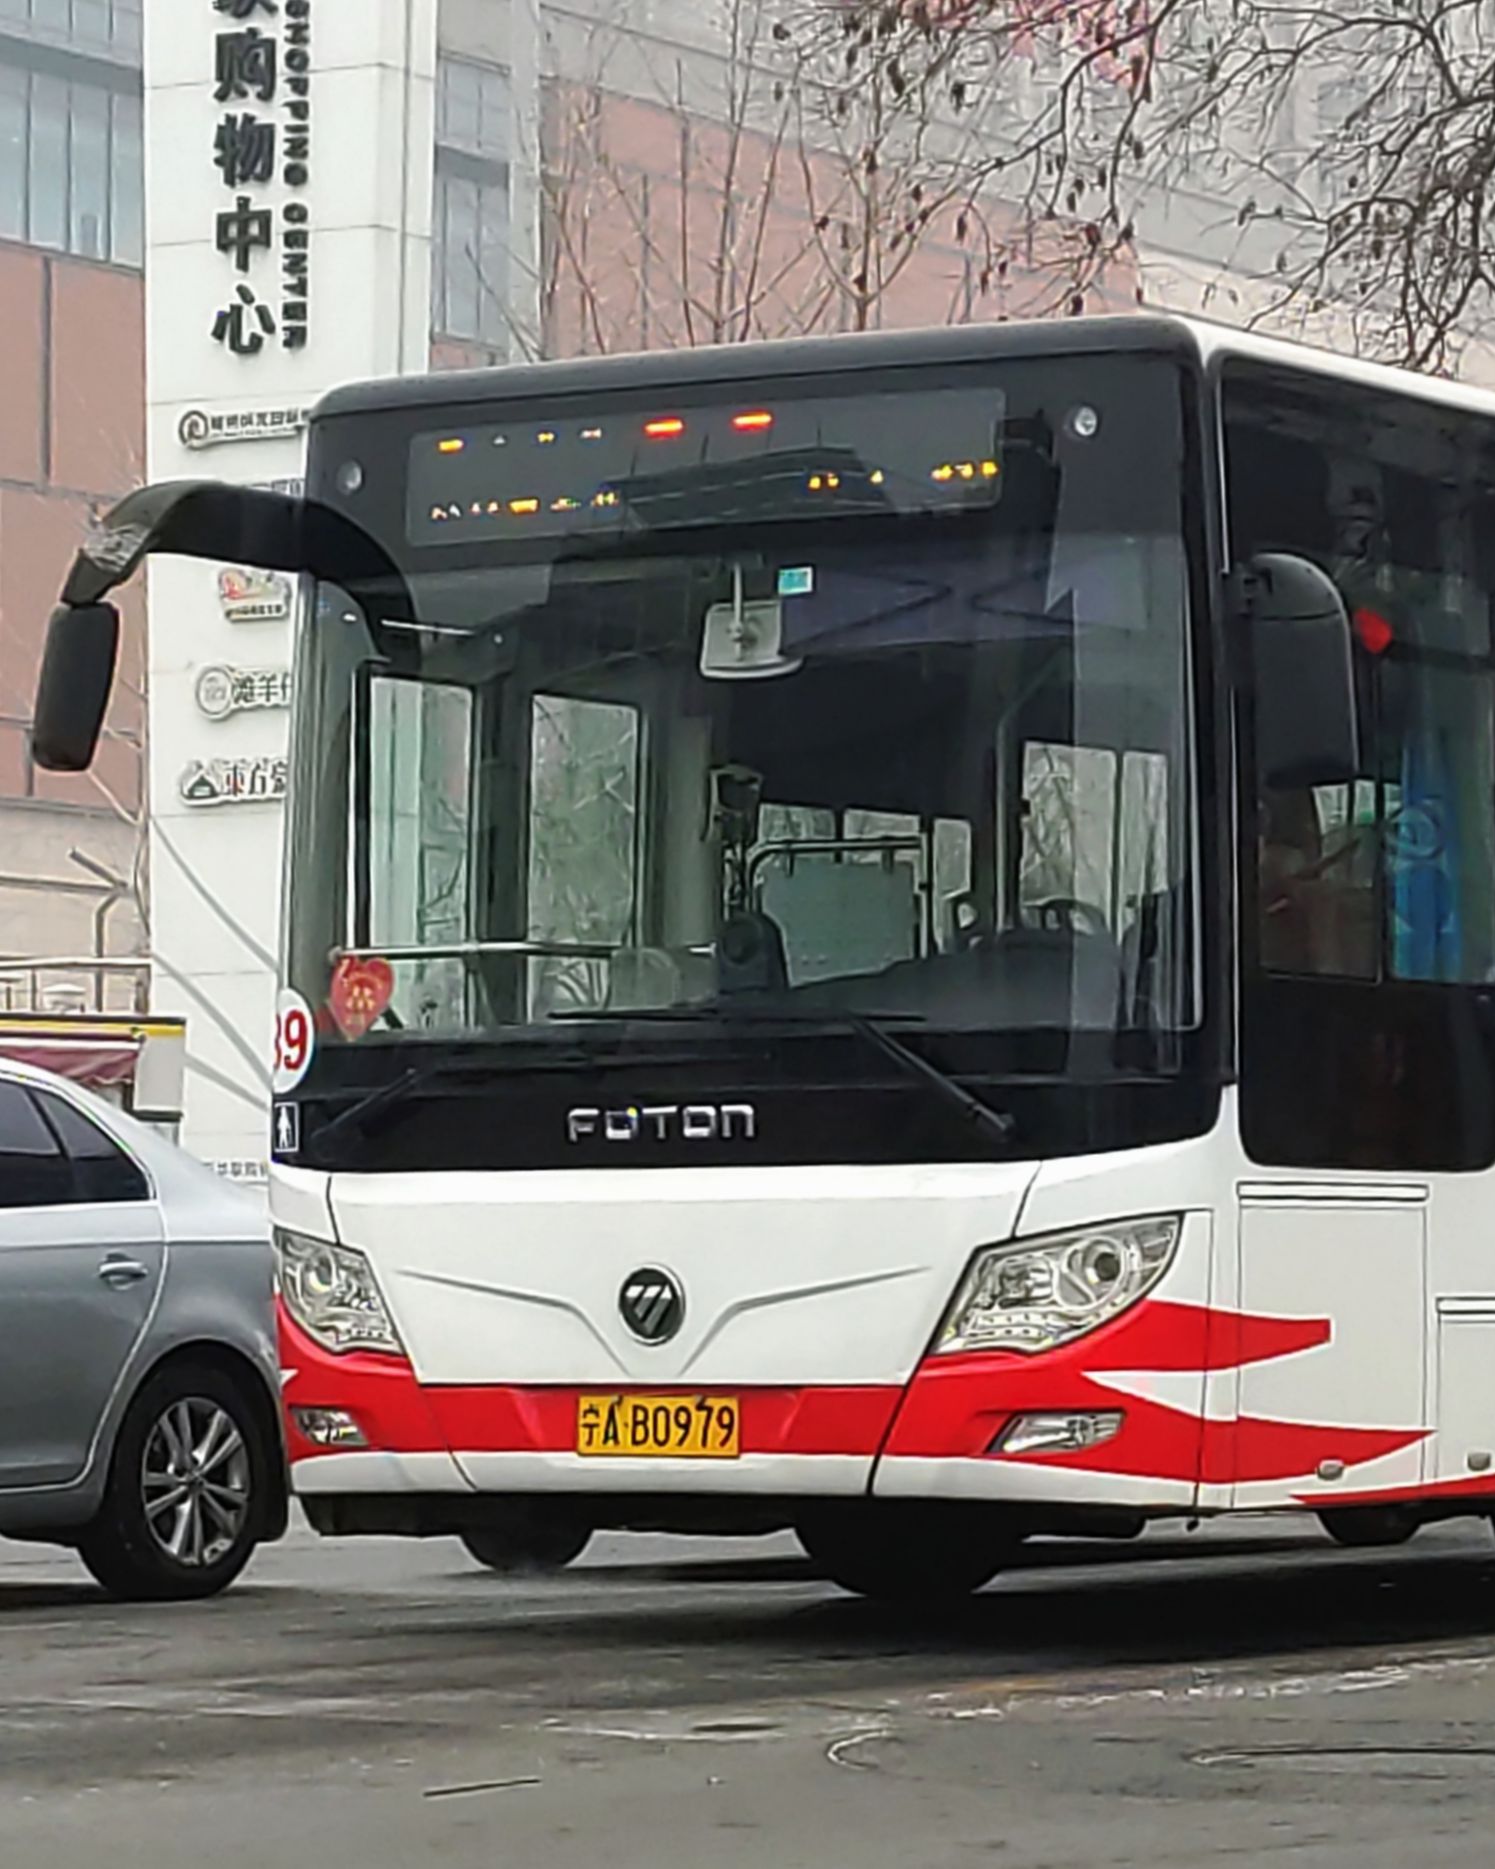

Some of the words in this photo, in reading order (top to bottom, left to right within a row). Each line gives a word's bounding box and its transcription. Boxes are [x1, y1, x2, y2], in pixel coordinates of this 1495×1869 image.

[213, 0, 277, 355] 购物中心
[282, 202, 309, 349] CENTER
[569, 1104, 755, 1142] FOTON
